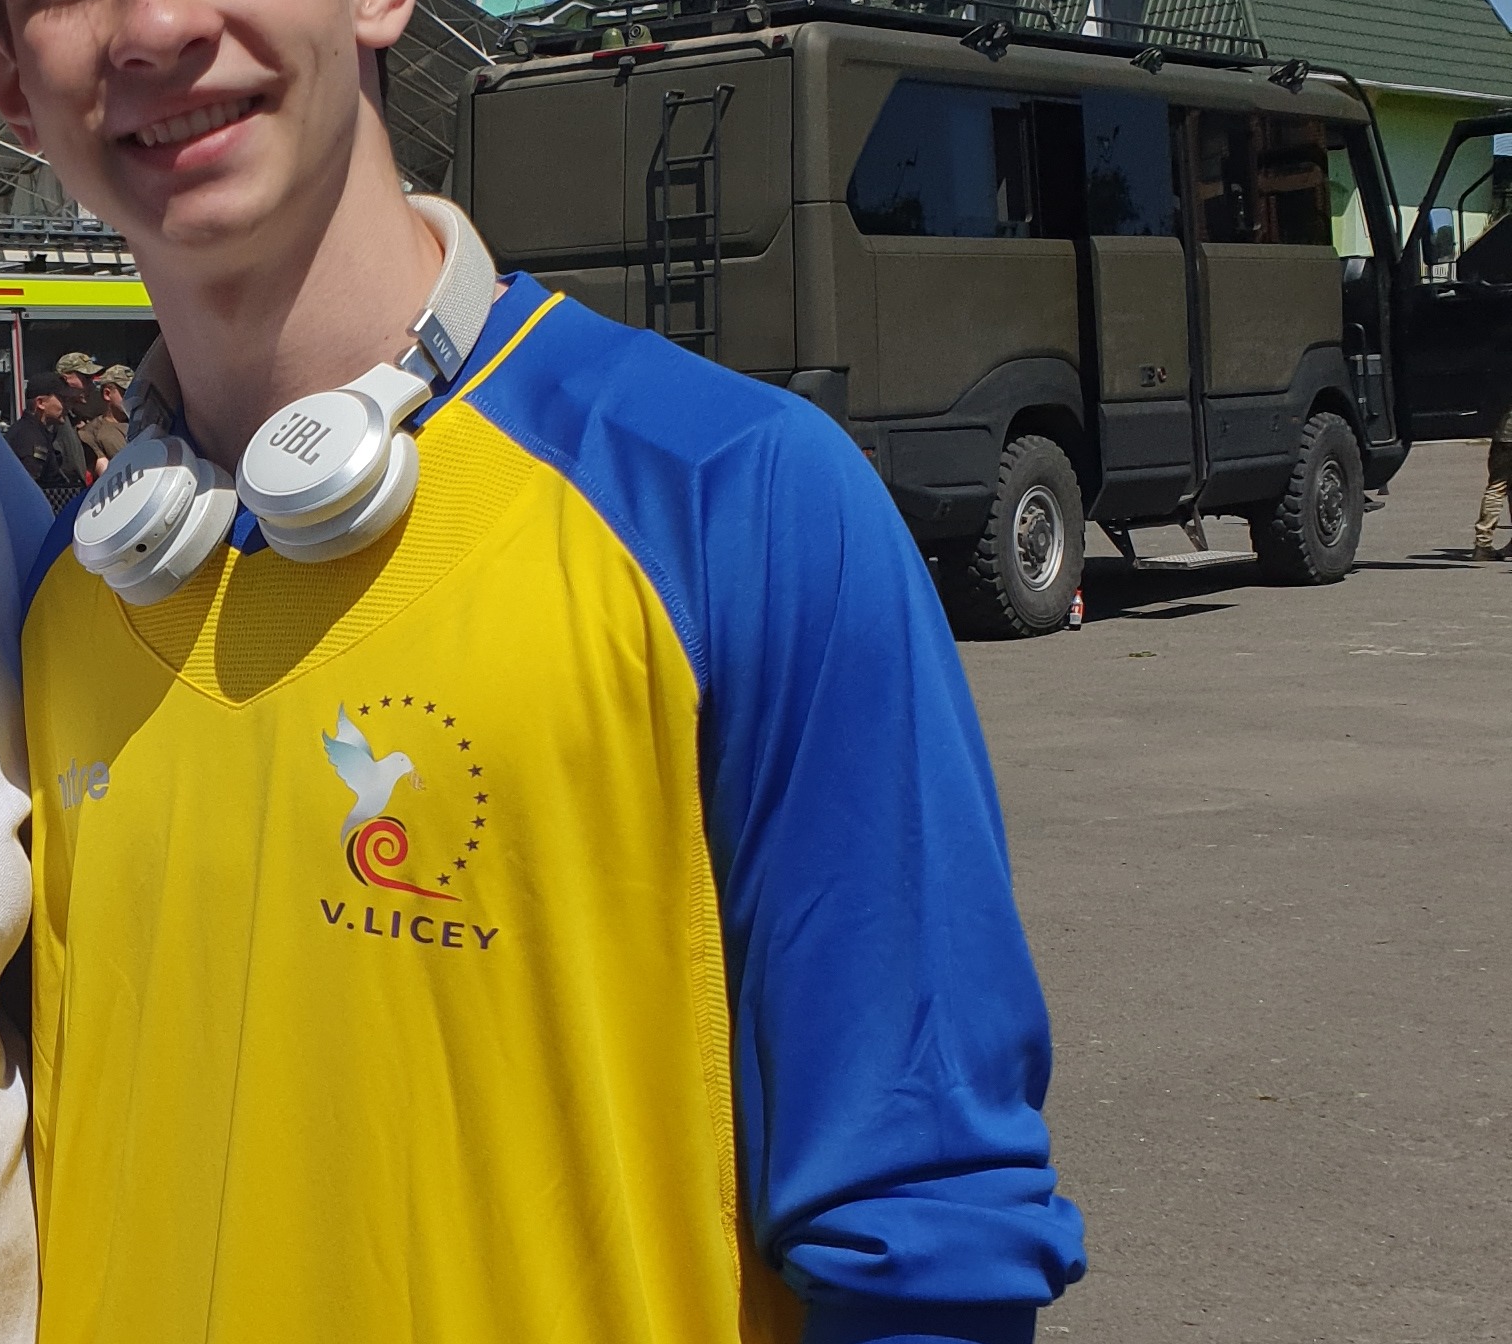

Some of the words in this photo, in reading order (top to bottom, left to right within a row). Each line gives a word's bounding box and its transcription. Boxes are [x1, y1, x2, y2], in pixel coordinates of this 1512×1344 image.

[432, 332, 452, 364] LIVE
[269, 412, 332, 466] JBL
[89, 463, 144, 518] JBL
